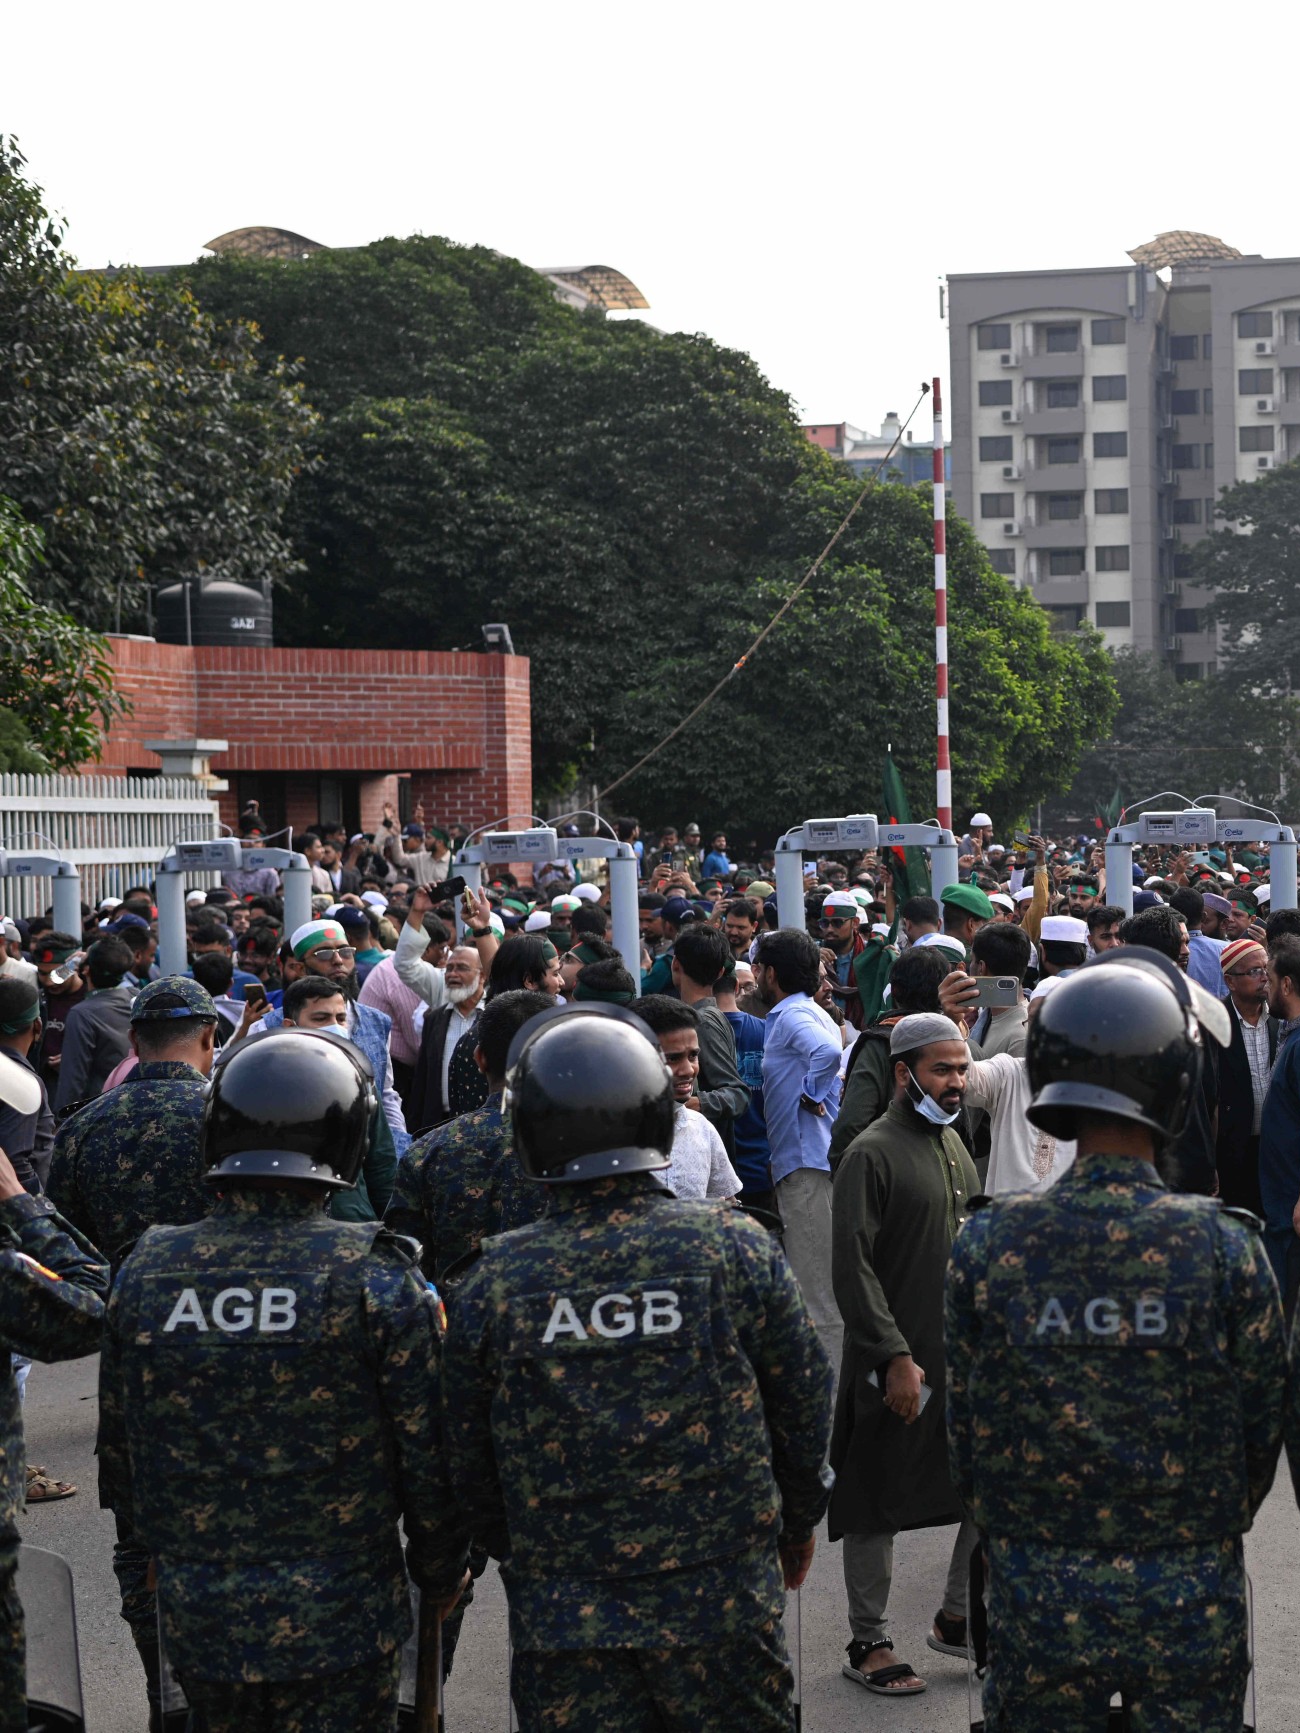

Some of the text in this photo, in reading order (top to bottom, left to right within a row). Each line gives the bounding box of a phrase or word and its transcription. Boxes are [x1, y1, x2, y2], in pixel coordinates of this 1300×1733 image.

[162, 1288, 297, 1332] AGB
[541, 1291, 683, 1344] AGB
[1036, 1297, 1168, 1336] AGB
